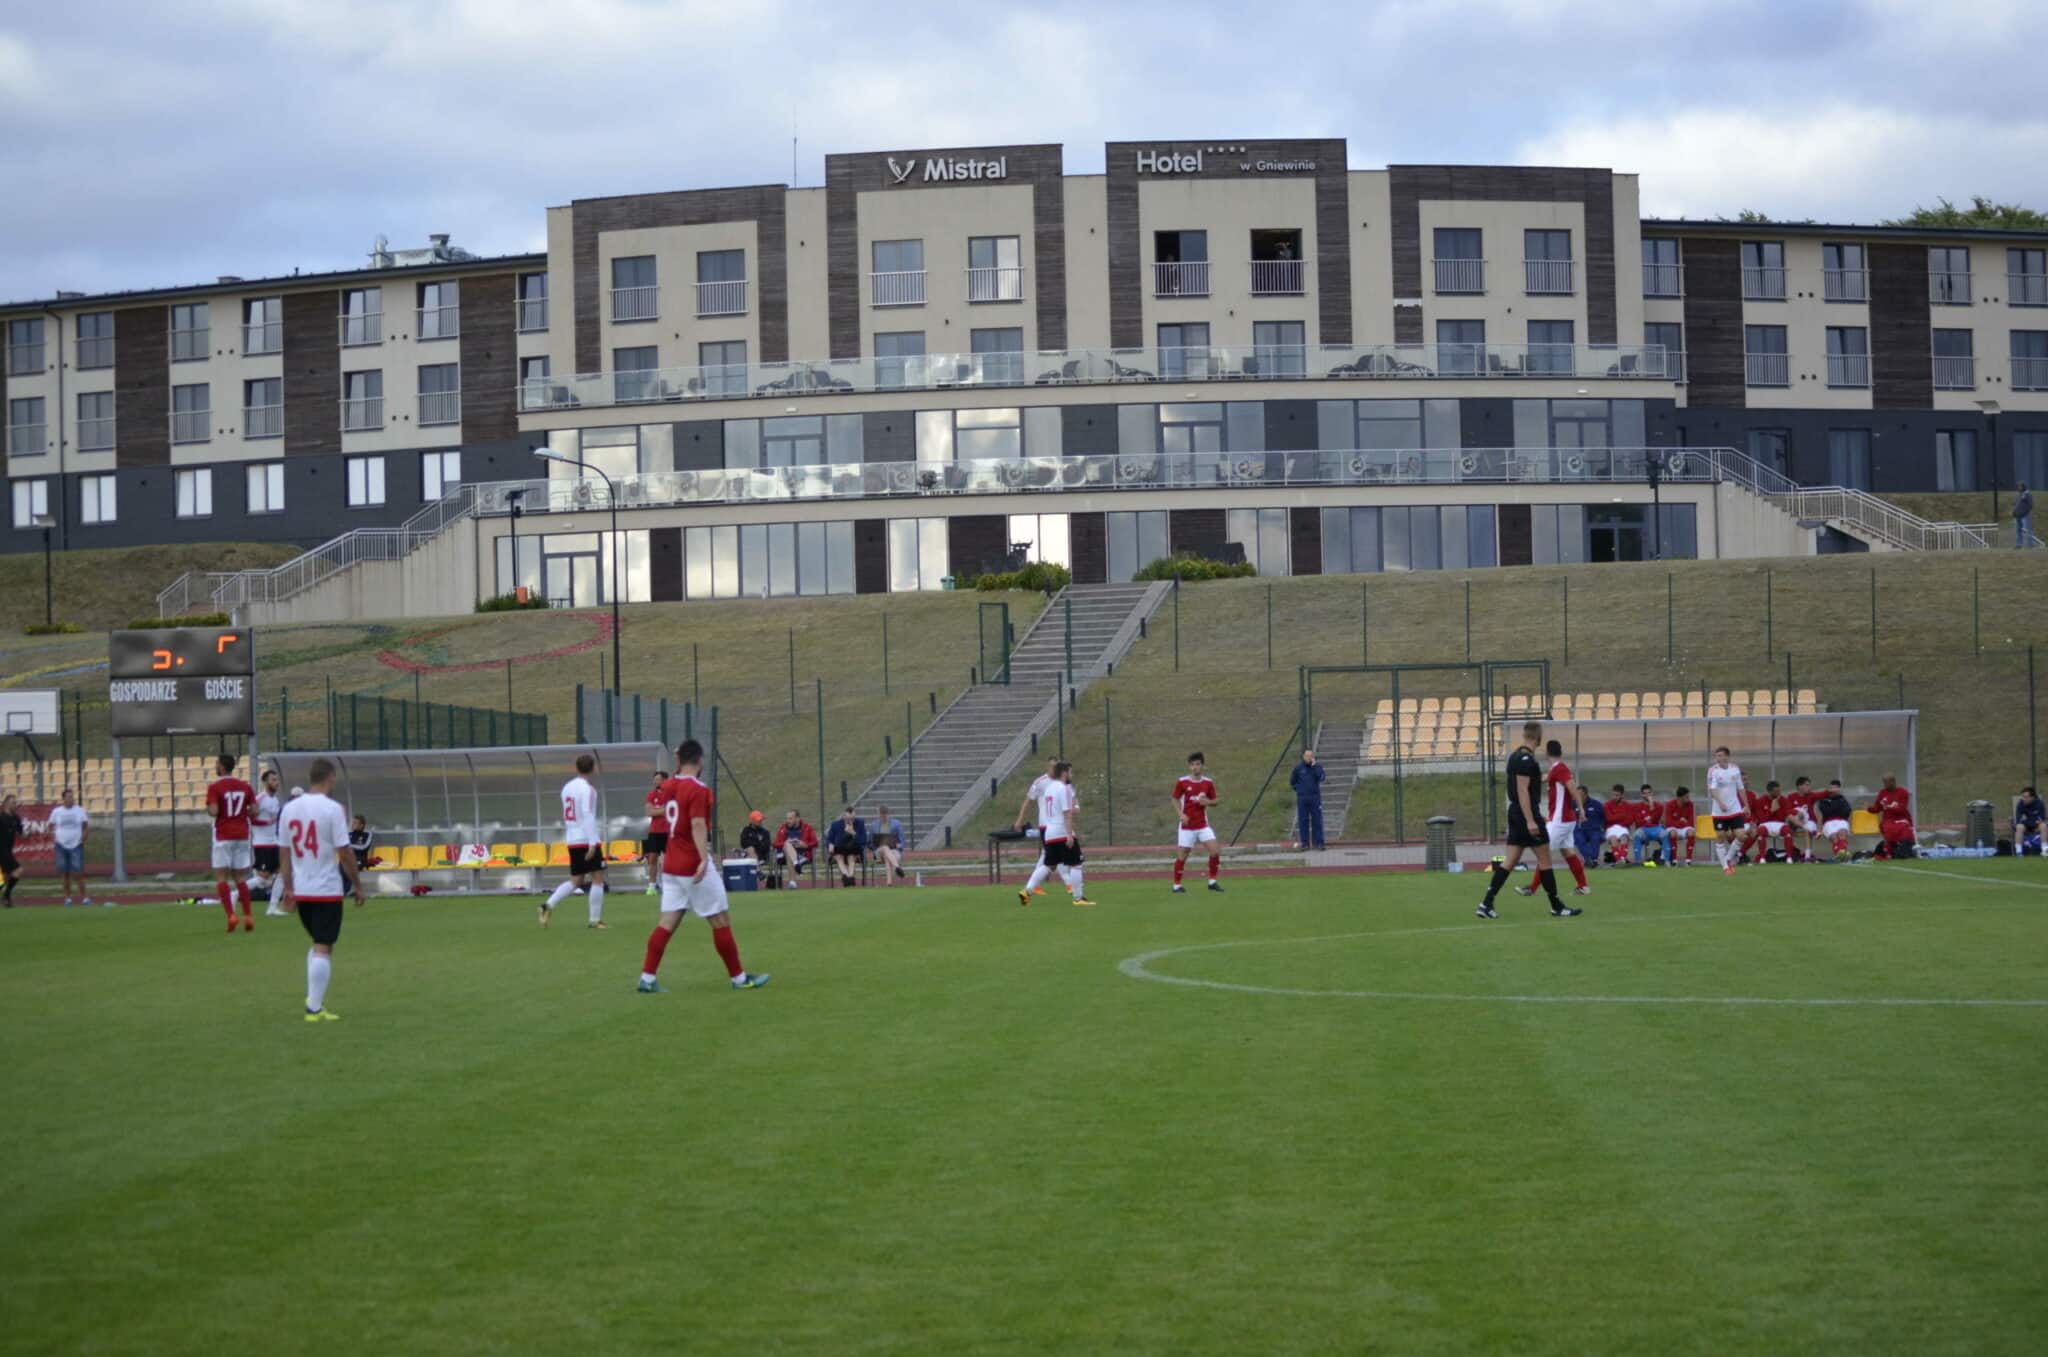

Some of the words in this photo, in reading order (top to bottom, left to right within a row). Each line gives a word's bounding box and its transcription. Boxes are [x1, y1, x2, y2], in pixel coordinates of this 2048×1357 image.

[924, 156, 1006, 181] Mistral
[1137, 150, 1202, 173] Hotel
[1240, 163, 1250, 171] w
[1257, 160, 1316, 171] Gniewinie
[110, 681, 178, 702] GOSPODARZE
[205, 676, 243, 700] GOŚCIE
[224, 791, 245, 817] 17
[665, 800, 679, 838] 9
[288, 819, 318, 859] 24
